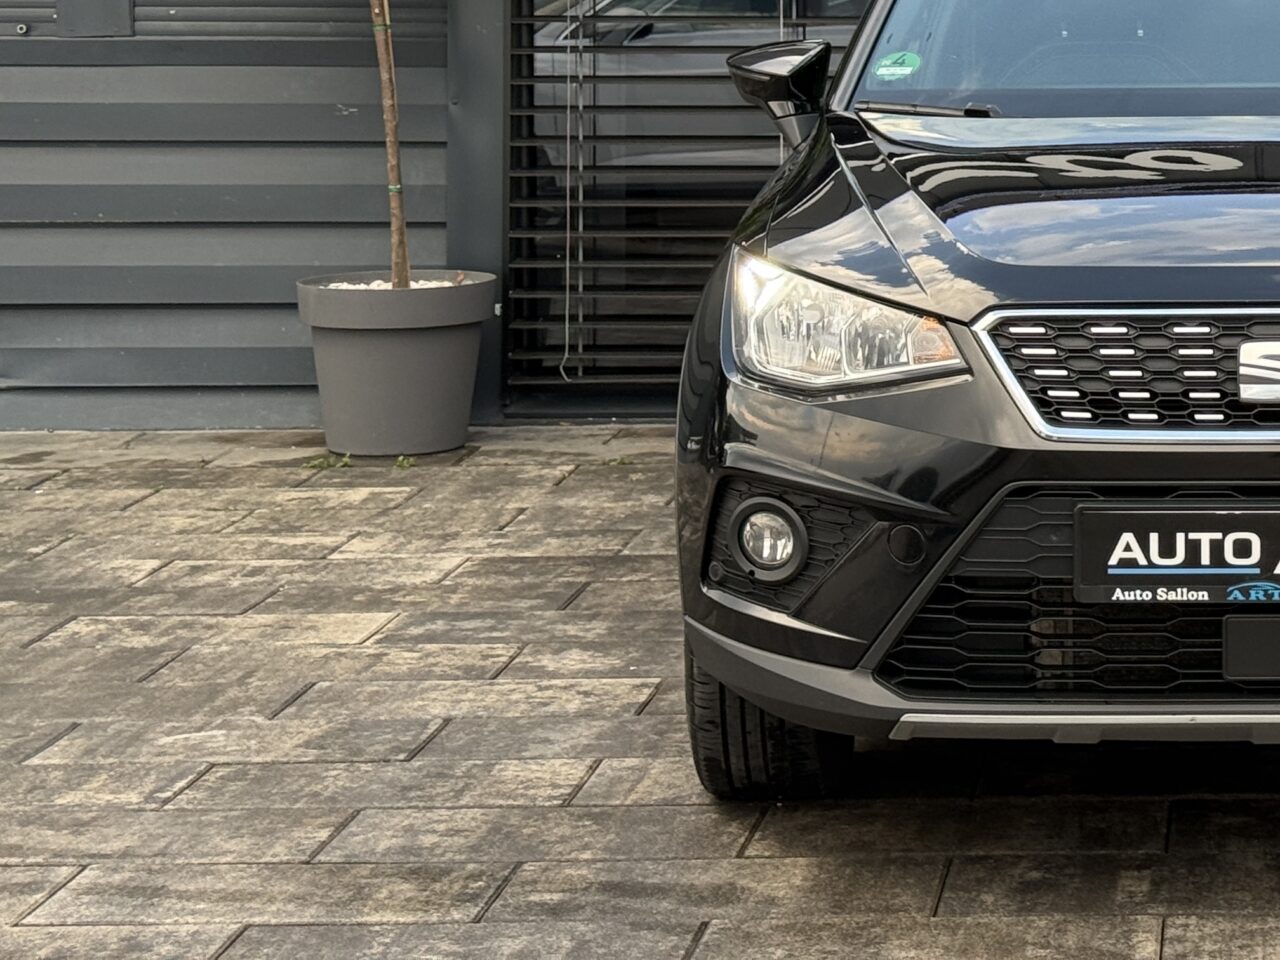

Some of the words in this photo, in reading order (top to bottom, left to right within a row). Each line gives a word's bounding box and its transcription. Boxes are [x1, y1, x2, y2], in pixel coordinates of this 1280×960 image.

[892, 52, 906, 65] 4
[1107, 531, 1262, 566] AUTO
[1111, 587, 1152, 601] Auto
[1156, 587, 1209, 601] Sallon
